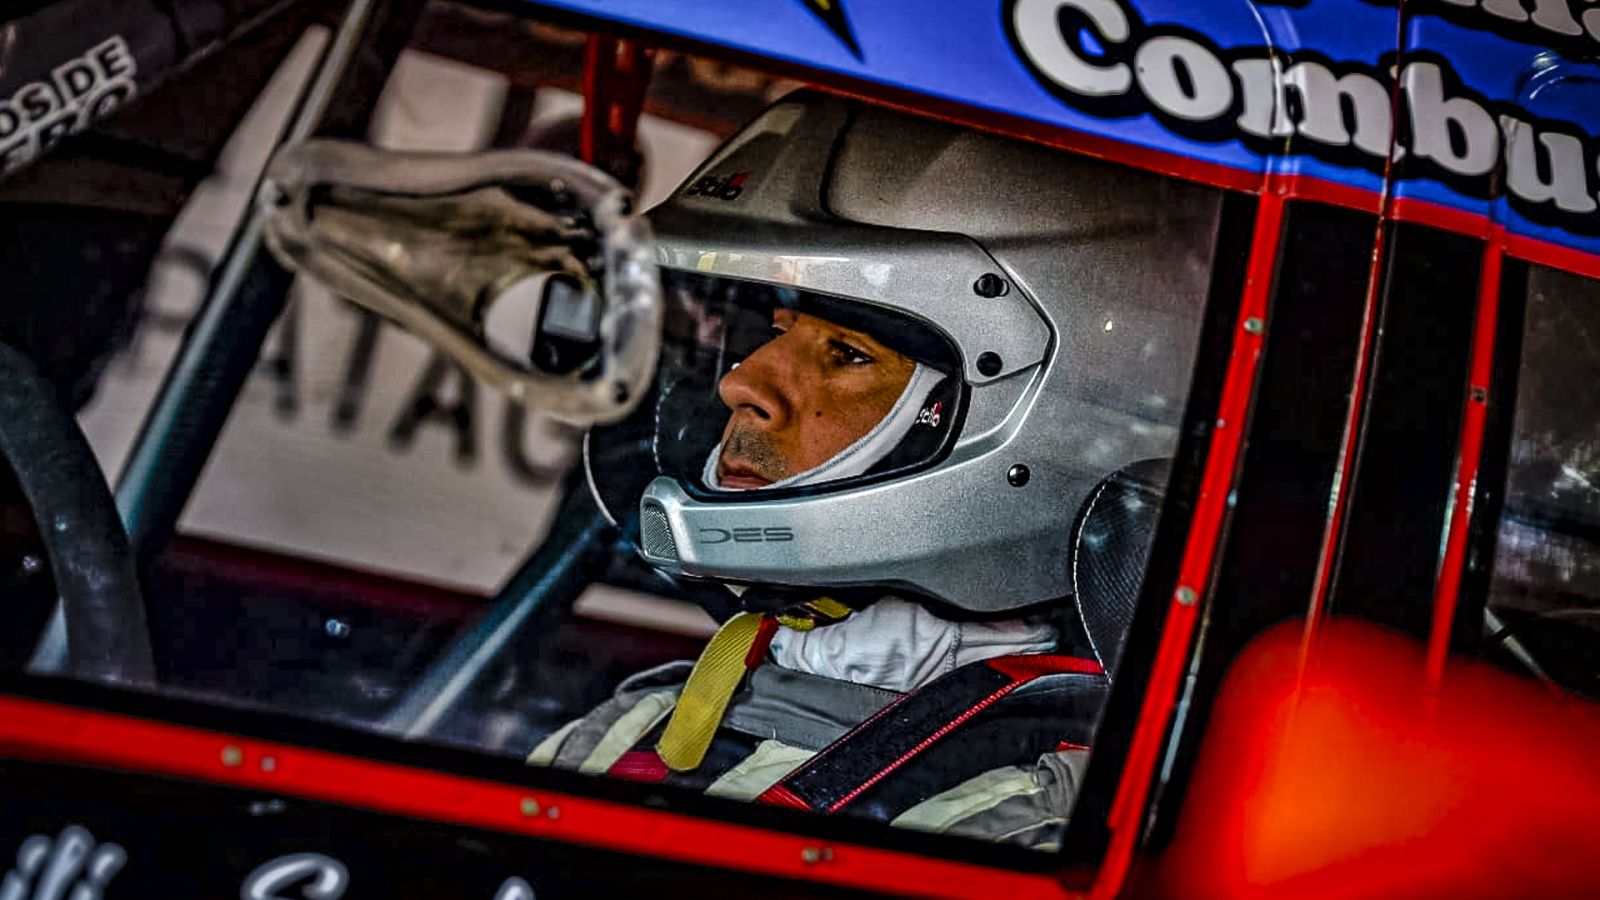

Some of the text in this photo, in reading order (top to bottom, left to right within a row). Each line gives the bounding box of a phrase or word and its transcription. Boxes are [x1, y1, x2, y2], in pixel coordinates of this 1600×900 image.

[62, 40, 131, 98] DE
[1012, 0, 1600, 214] Combu
[700, 527, 794, 544] DES
